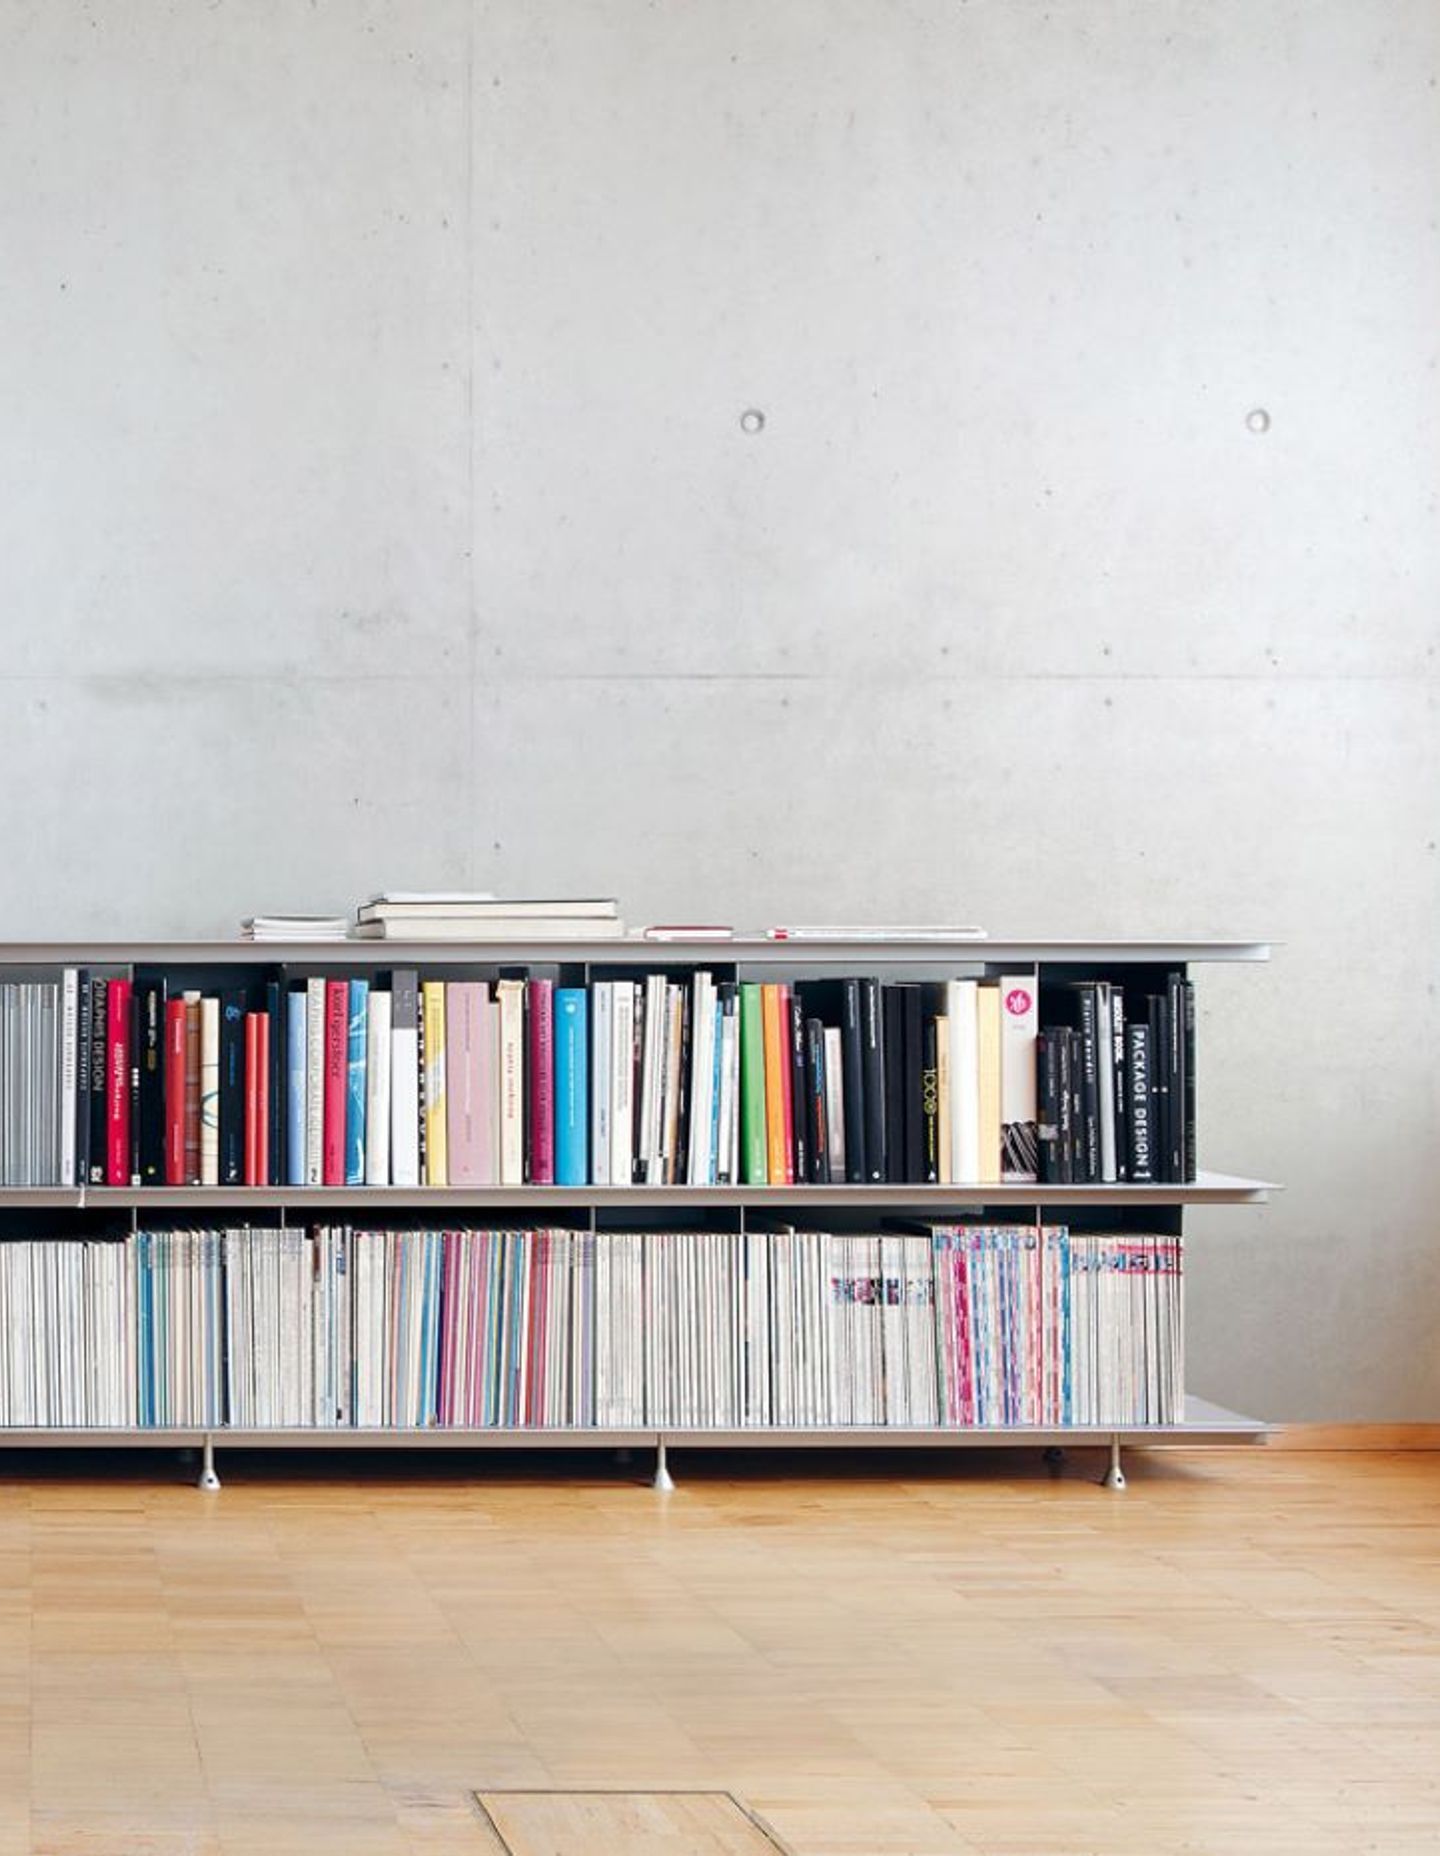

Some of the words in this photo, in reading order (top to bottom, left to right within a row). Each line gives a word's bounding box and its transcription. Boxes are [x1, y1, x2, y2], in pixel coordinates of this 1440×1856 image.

[92, 1040, 105, 1092] DESIGN
[1132, 1031, 1146, 1102] PACKAGE
[1134, 1108, 1148, 1166] DESIGN
